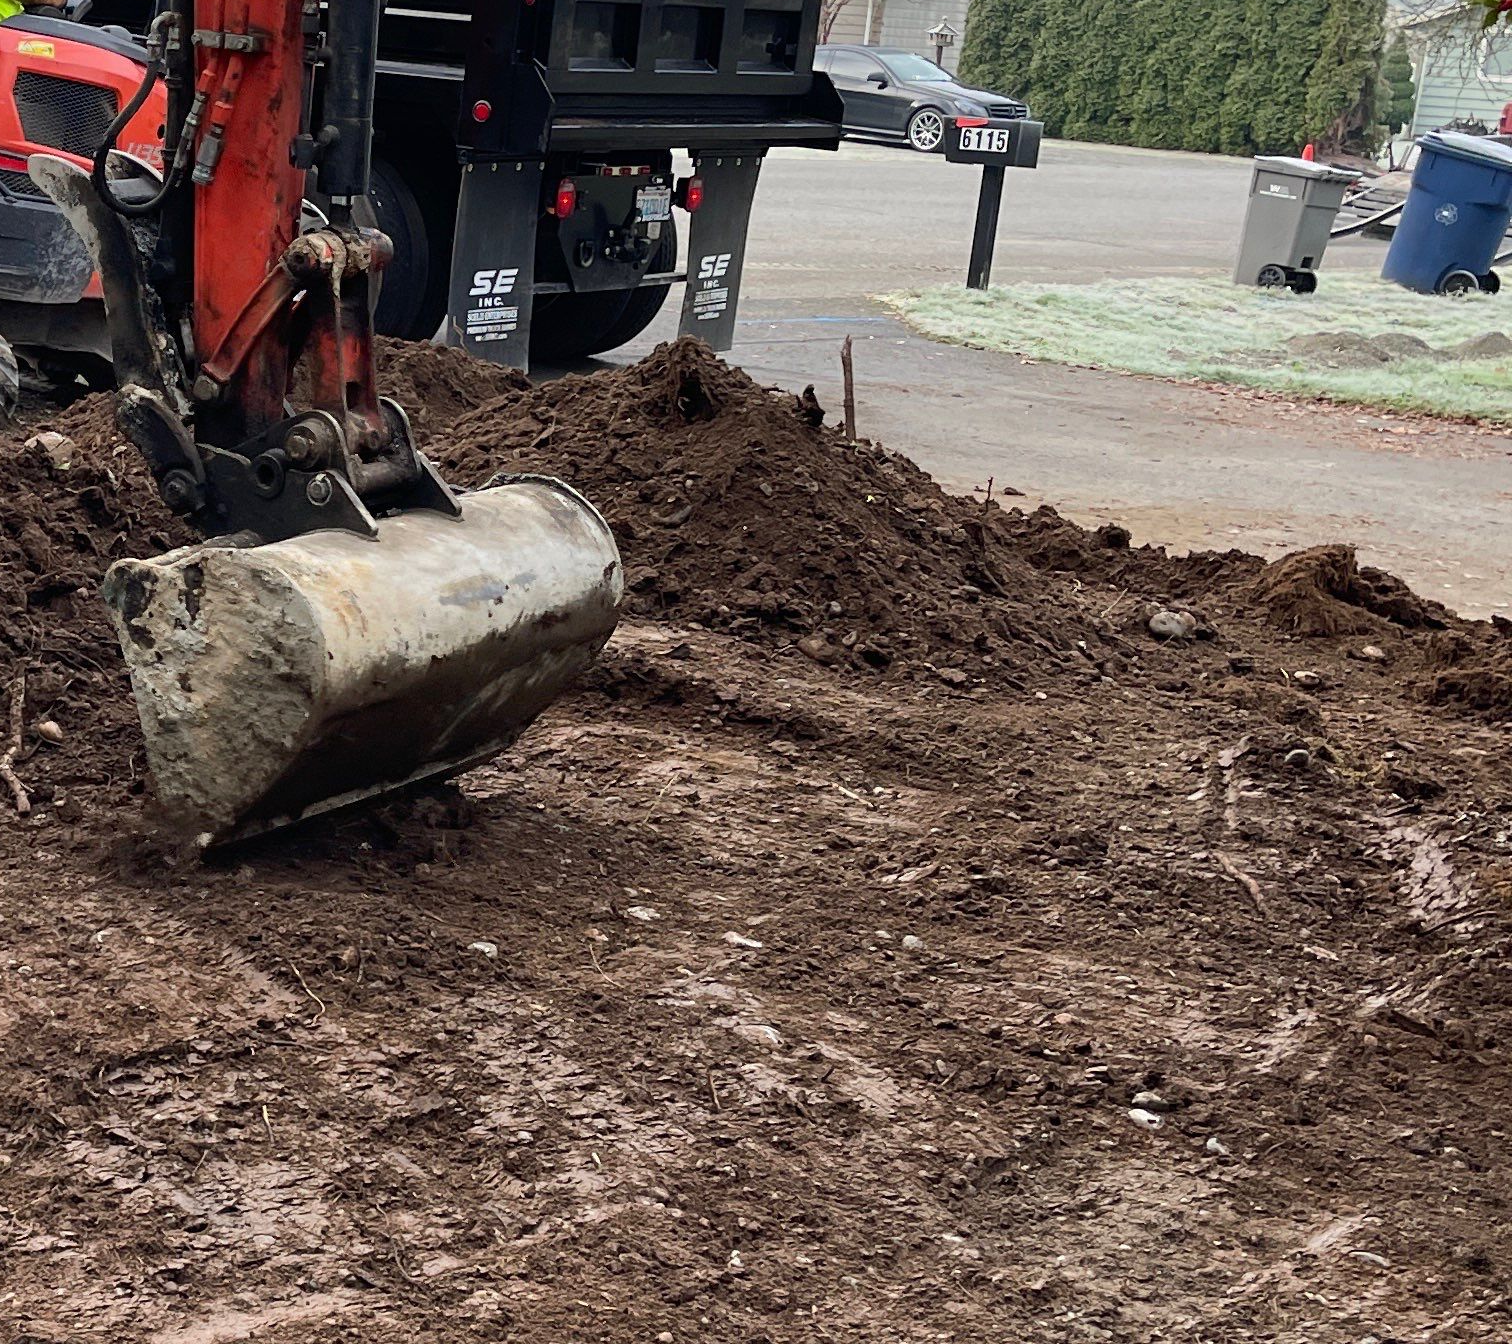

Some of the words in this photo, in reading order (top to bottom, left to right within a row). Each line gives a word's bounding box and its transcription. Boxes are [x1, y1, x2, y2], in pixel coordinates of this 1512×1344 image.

[962, 129, 1007, 151] 6115
[697, 254, 731, 279] SE
[469, 269, 519, 296] SE
